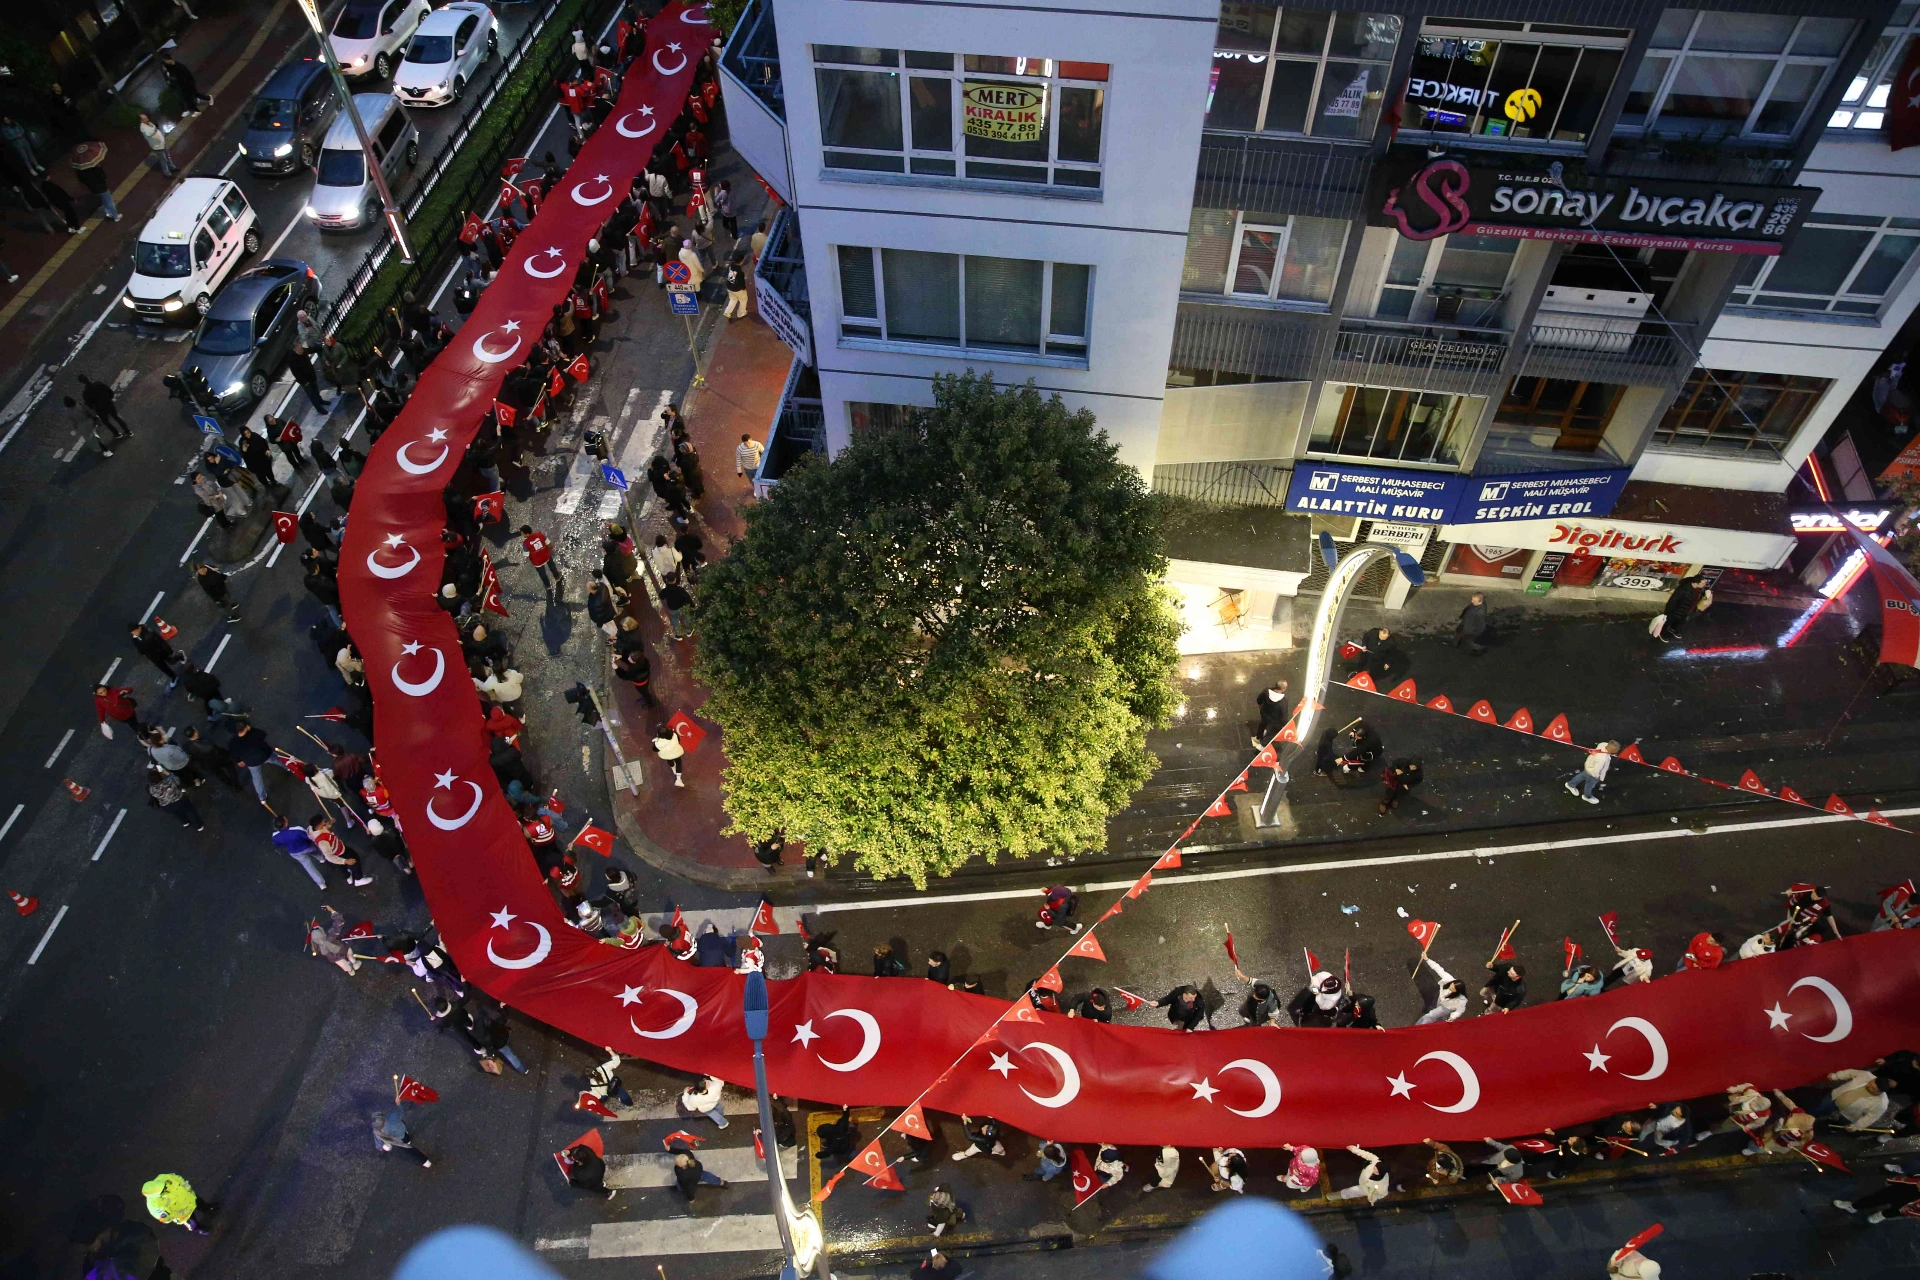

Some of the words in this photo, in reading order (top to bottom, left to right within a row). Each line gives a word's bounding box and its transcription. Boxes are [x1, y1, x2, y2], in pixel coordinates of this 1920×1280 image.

[978, 90, 1028, 106] MERT
[968, 118, 992, 128] 435
[996, 122, 1014, 131] 77
[1018, 124, 1036, 132] 89
[968, 126, 988, 136] 0533
[992, 130, 1008, 139] 394
[1490, 186, 1614, 226] sonay
[1620, 186, 1763, 232] bıçakçı
[1774, 204, 1798, 214] 435
[1766, 212, 1793, 224] 26
[1762, 224, 1786, 236] 86
[1476, 226, 1530, 239] Güzellik
[1534, 230, 1586, 242] Merkezi
[1602, 234, 1690, 250] Estetisyenlik
[1694, 241, 1732, 250] Kursu
[1341, 474, 1380, 485] SERBEST
[1382, 478, 1445, 490] MUHASEBECİ
[1511, 480, 1549, 489] SERBEST
[1550, 475, 1612, 486] MUHASEBECİ
[1355, 485, 1379, 494] MALİ
[1381, 488, 1424, 498] MÜŞAVİR
[1524, 488, 1548, 497] MALİ
[1548, 486, 1590, 497] MÜŞAVİR
[1297, 497, 1388, 516] ALAATTİN
[1392, 504, 1444, 520] KURU
[1475, 502, 1544, 520] SEÇKİN
[1546, 502, 1592, 515] EROL
[1548, 525, 1684, 556] Digiturk
[1621, 578, 1650, 587] 399
[1886, 599, 1907, 610] BU
